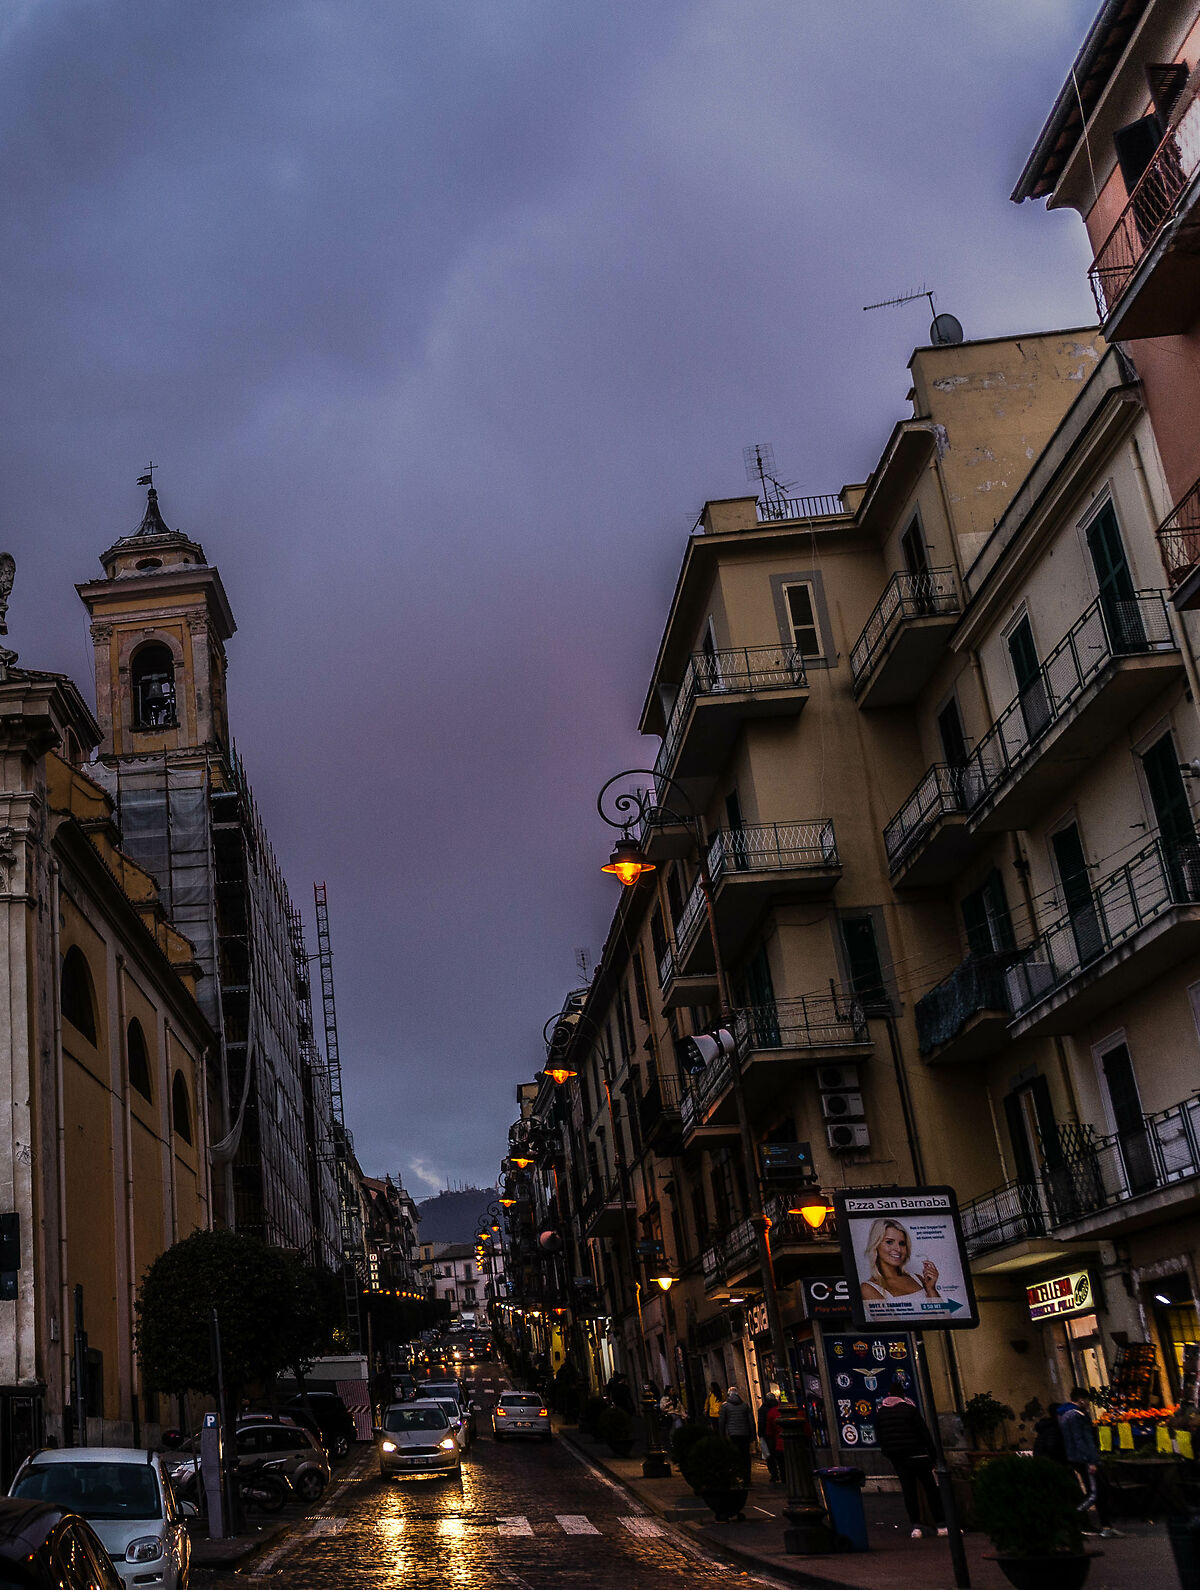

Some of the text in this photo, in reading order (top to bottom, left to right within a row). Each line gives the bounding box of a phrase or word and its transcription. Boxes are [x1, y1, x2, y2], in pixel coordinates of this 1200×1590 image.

[848, 1197, 947, 1210] P.zza San Barnaba
[206, 1415, 216, 1427] P
